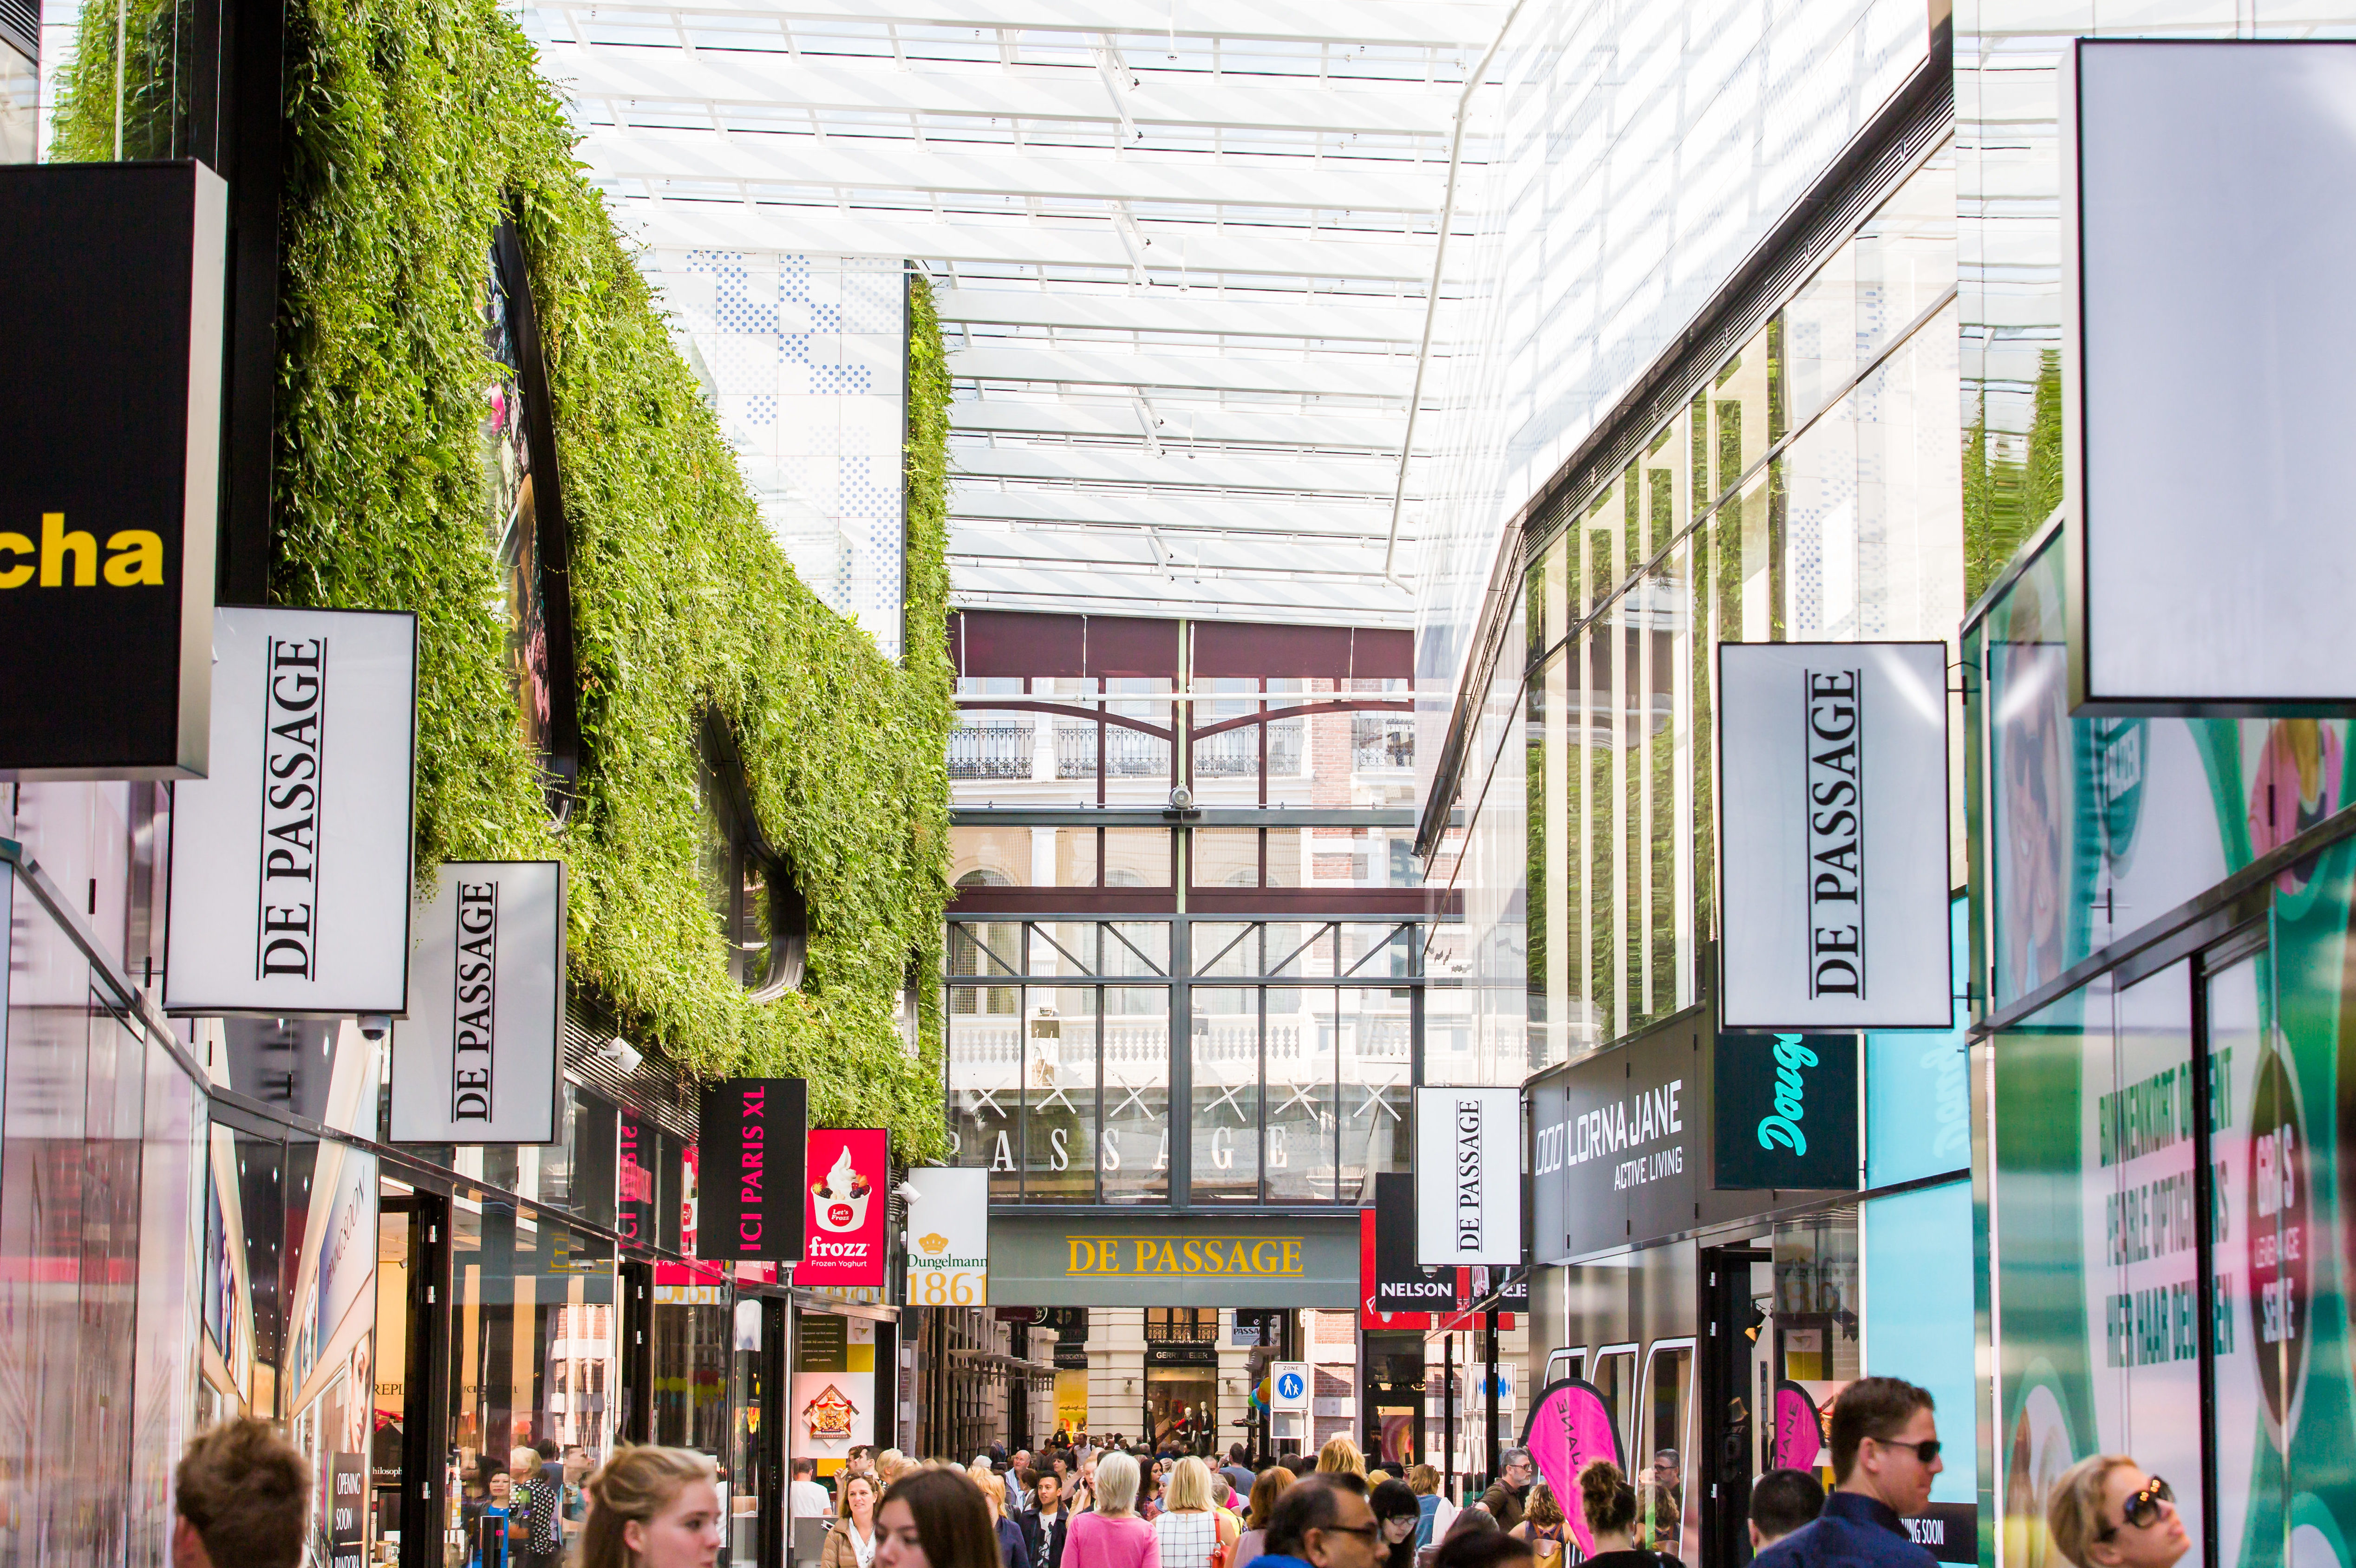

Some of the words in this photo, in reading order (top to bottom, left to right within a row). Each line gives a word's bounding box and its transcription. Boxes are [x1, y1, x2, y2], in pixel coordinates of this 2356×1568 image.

[267, 638, 320, 882] PASSAGE
[1811, 670, 1858, 904] PASSAGE
[263, 903, 311, 980] DE
[1815, 925, 1859, 998] DE
[458, 882, 493, 1054] PASSAGE
[456, 1068, 489, 1122] DE
[743, 1086, 764, 1118] XL
[741, 1126, 764, 1203] PARIS
[1460, 1100, 1479, 1209] PASSAGE
[1614, 1157, 1647, 1191] ACTIVE
[1650, 1146, 1682, 1181] LIVING
[344, 1164, 365, 1250] SOON
[740, 1213, 762, 1250] ICI
[809, 1236, 868, 1256] frozz
[1460, 1218, 1479, 1252] DE
[907, 1254, 987, 1270] Dungelmann
[1066, 1240, 1120, 1272] DE
[1133, 1240, 1304, 1273] PASSAGE
[1381, 1283, 1452, 1297] NELSON
[337, 1472, 361, 1495] OPENING
[336, 1508, 352, 1530] SOON
[1922, 1519, 1944, 1545] SOON
